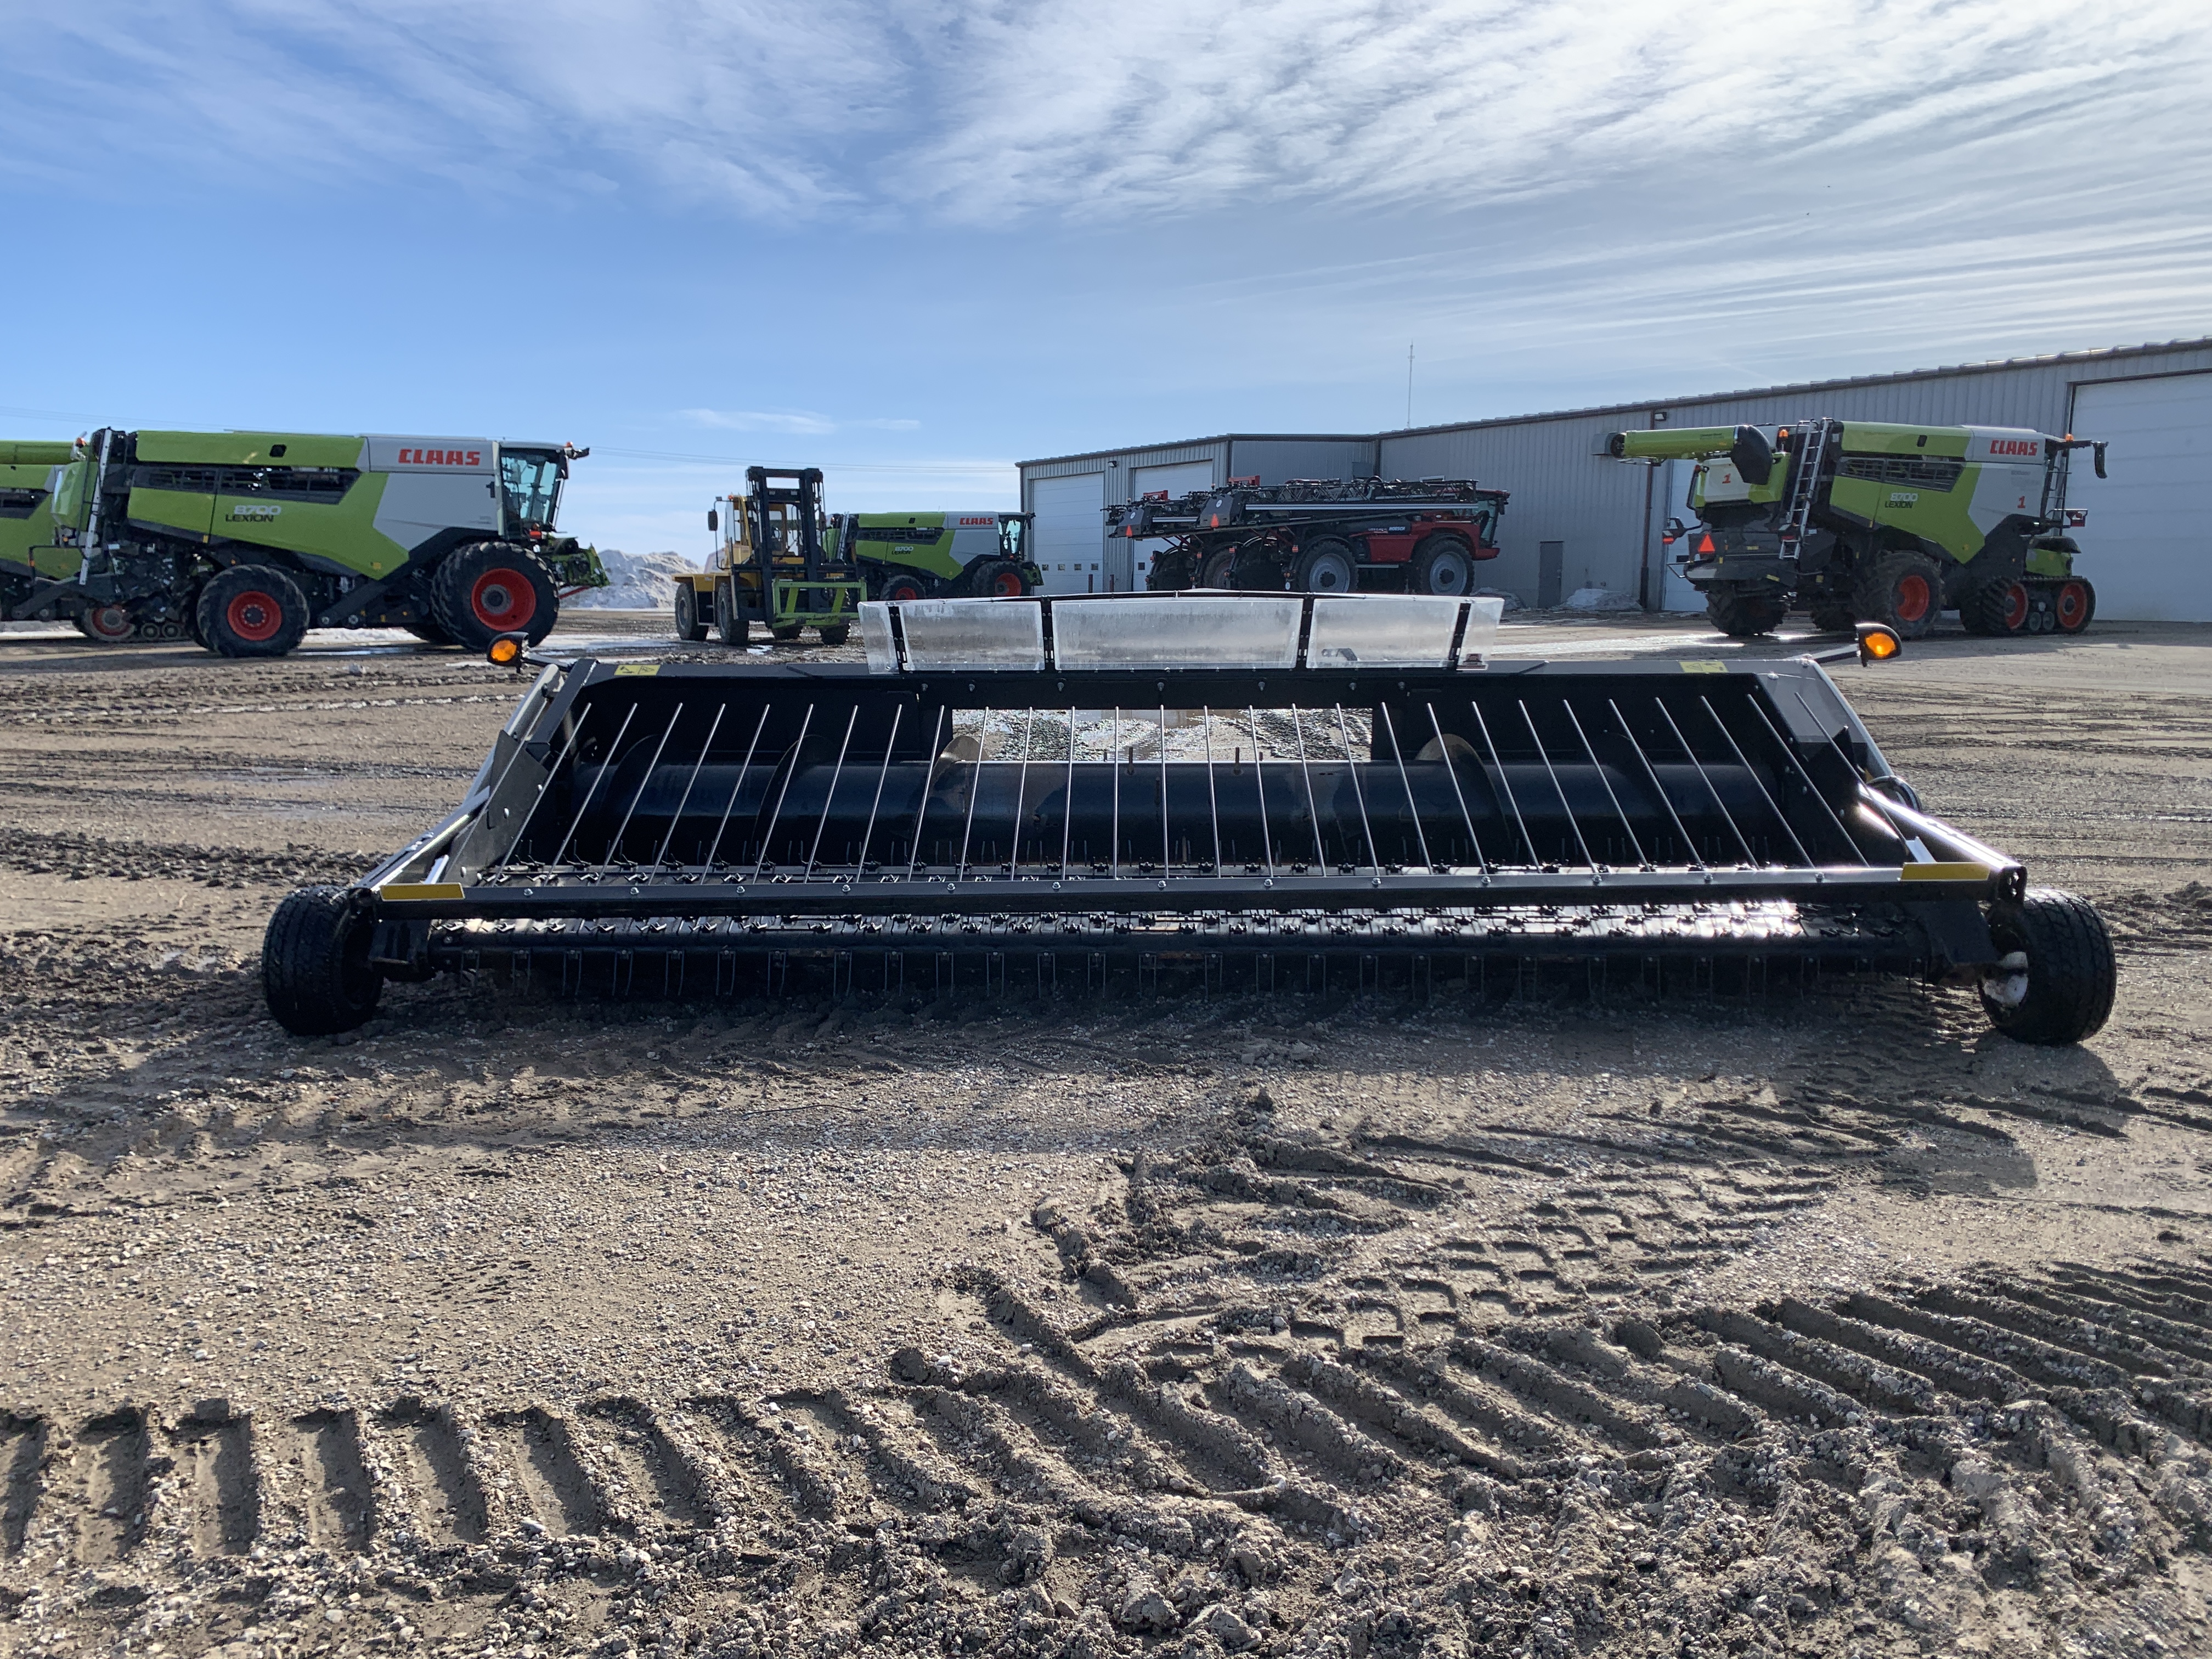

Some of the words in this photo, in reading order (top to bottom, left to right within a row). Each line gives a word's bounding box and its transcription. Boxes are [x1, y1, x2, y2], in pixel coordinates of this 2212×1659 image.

[1990, 440, 2038, 456] CLAAS
[398, 449, 480, 466] CLAAS
[1722, 473, 1731, 484] 1
[2017, 496, 2026, 509] 1
[234, 505, 281, 515] 8700
[225, 514, 274, 522] LEXION
